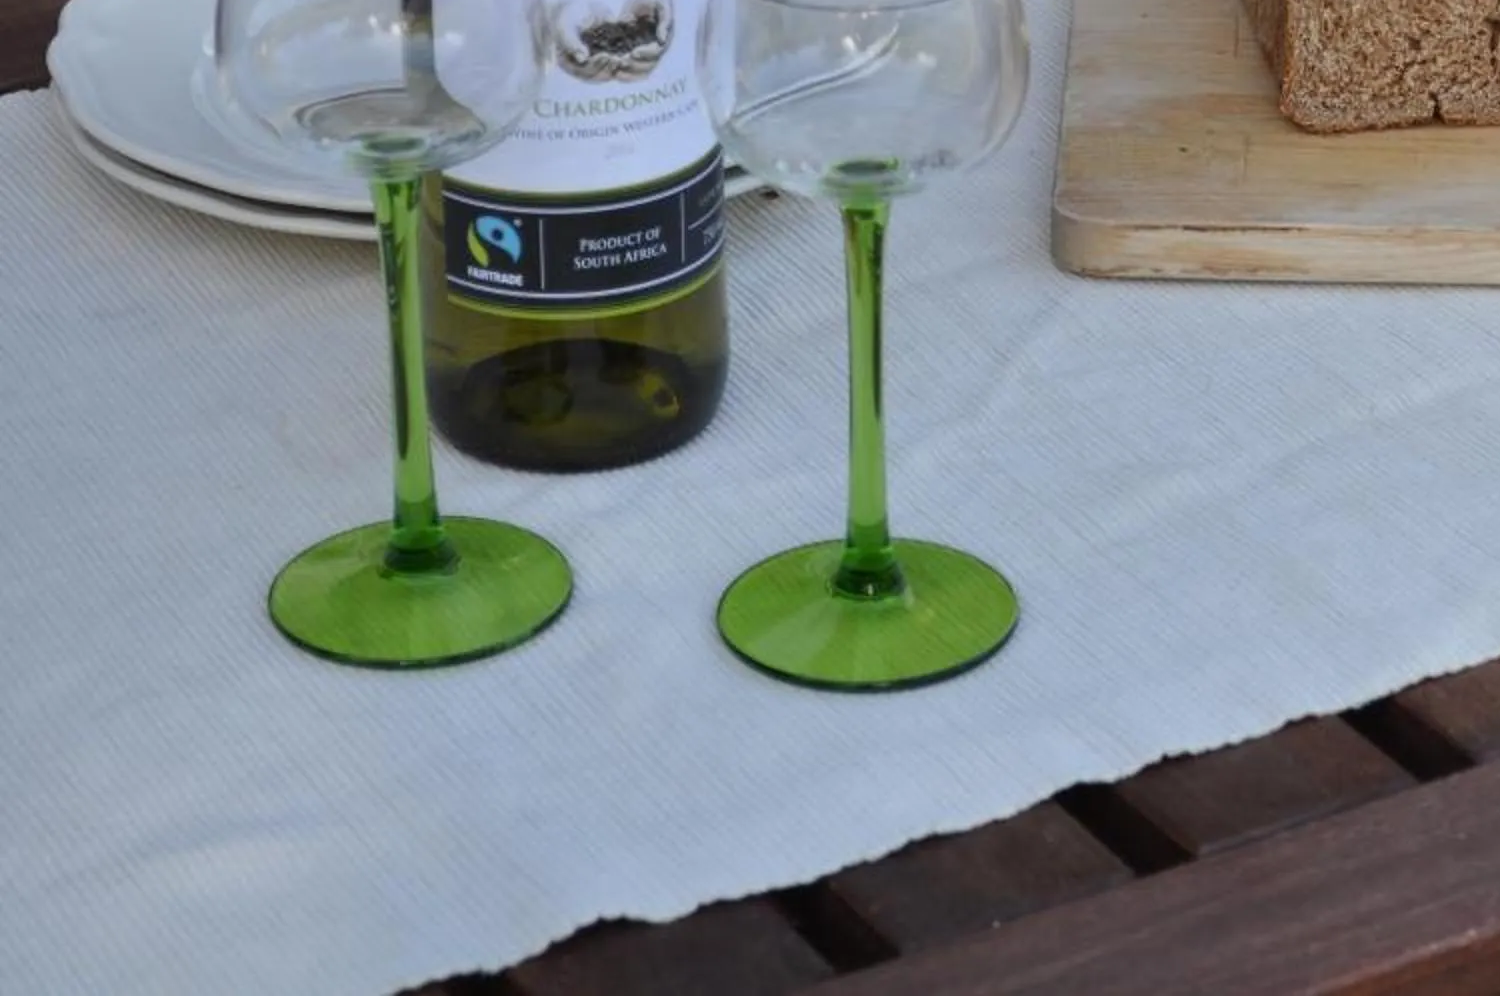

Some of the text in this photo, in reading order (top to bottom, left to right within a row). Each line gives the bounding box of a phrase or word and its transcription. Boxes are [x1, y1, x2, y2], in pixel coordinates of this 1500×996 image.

[579, 226, 662, 252] PRODUCT OF
[572, 243, 668, 271] SOUTH AFRICA
[467, 265, 524, 287] FAIRTRADE
